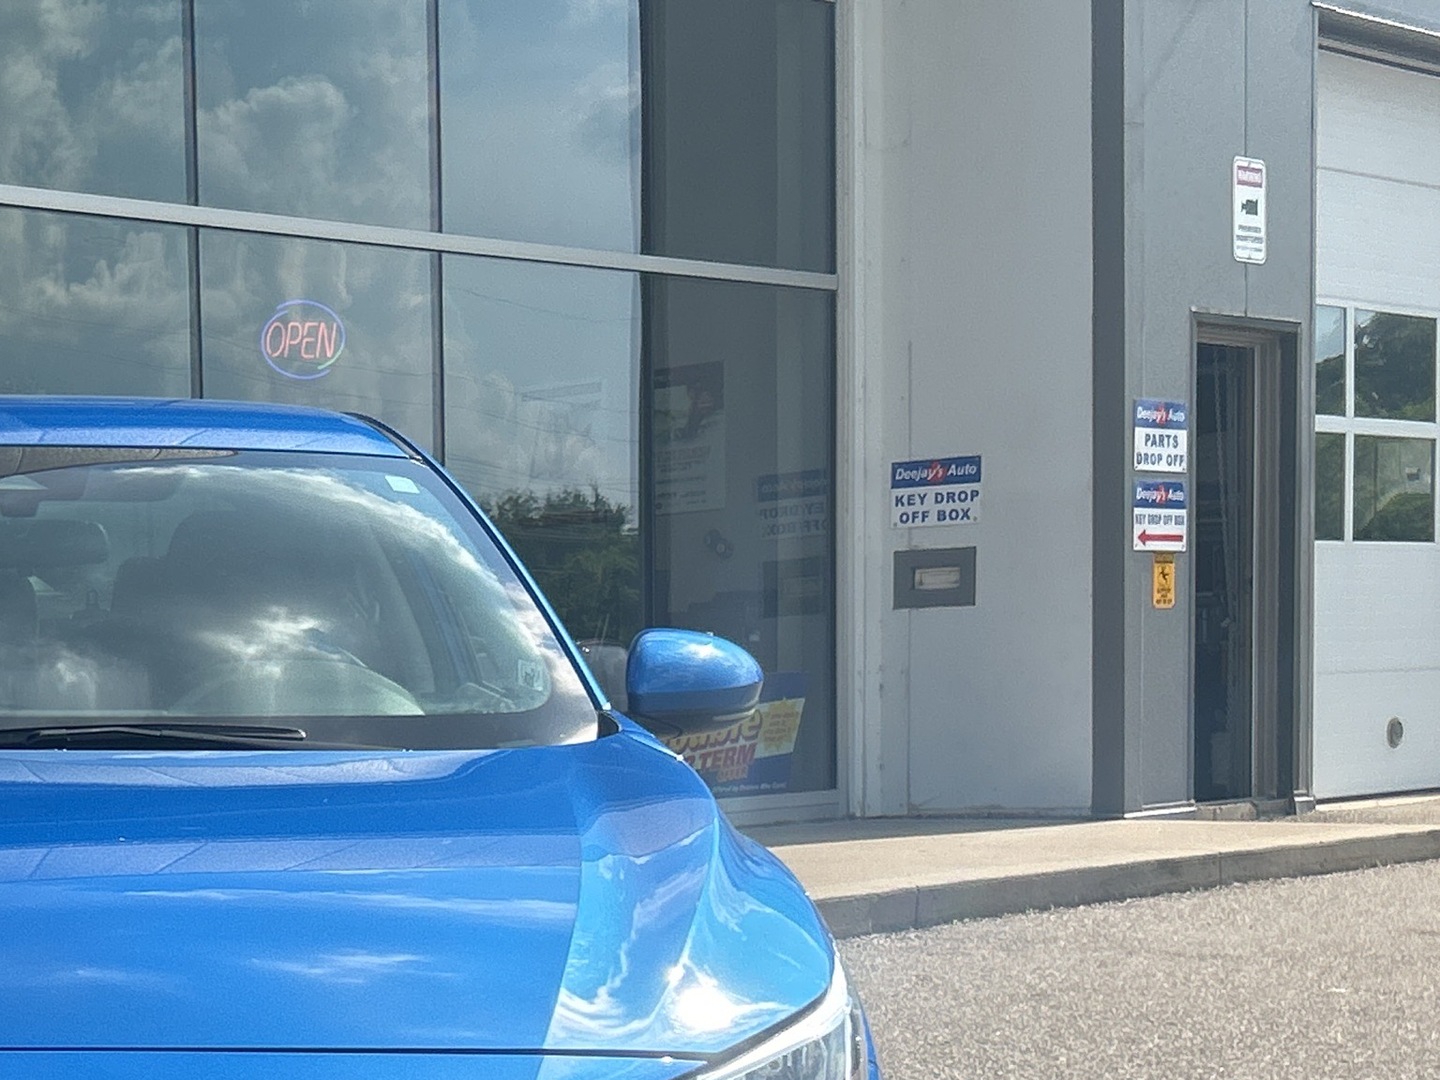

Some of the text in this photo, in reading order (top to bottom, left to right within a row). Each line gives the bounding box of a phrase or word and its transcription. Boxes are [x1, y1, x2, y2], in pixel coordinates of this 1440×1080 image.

[266, 322, 337, 358] OPEN
[1144, 433, 1179, 449] PARTS
[1136, 452, 1185, 467] DROP OFF
[895, 462, 977, 481] Deejay's Auto
[895, 489, 980, 507] KEY DROP
[899, 507, 972, 524] OFF BOX
[699, 743, 758, 770] TERM
